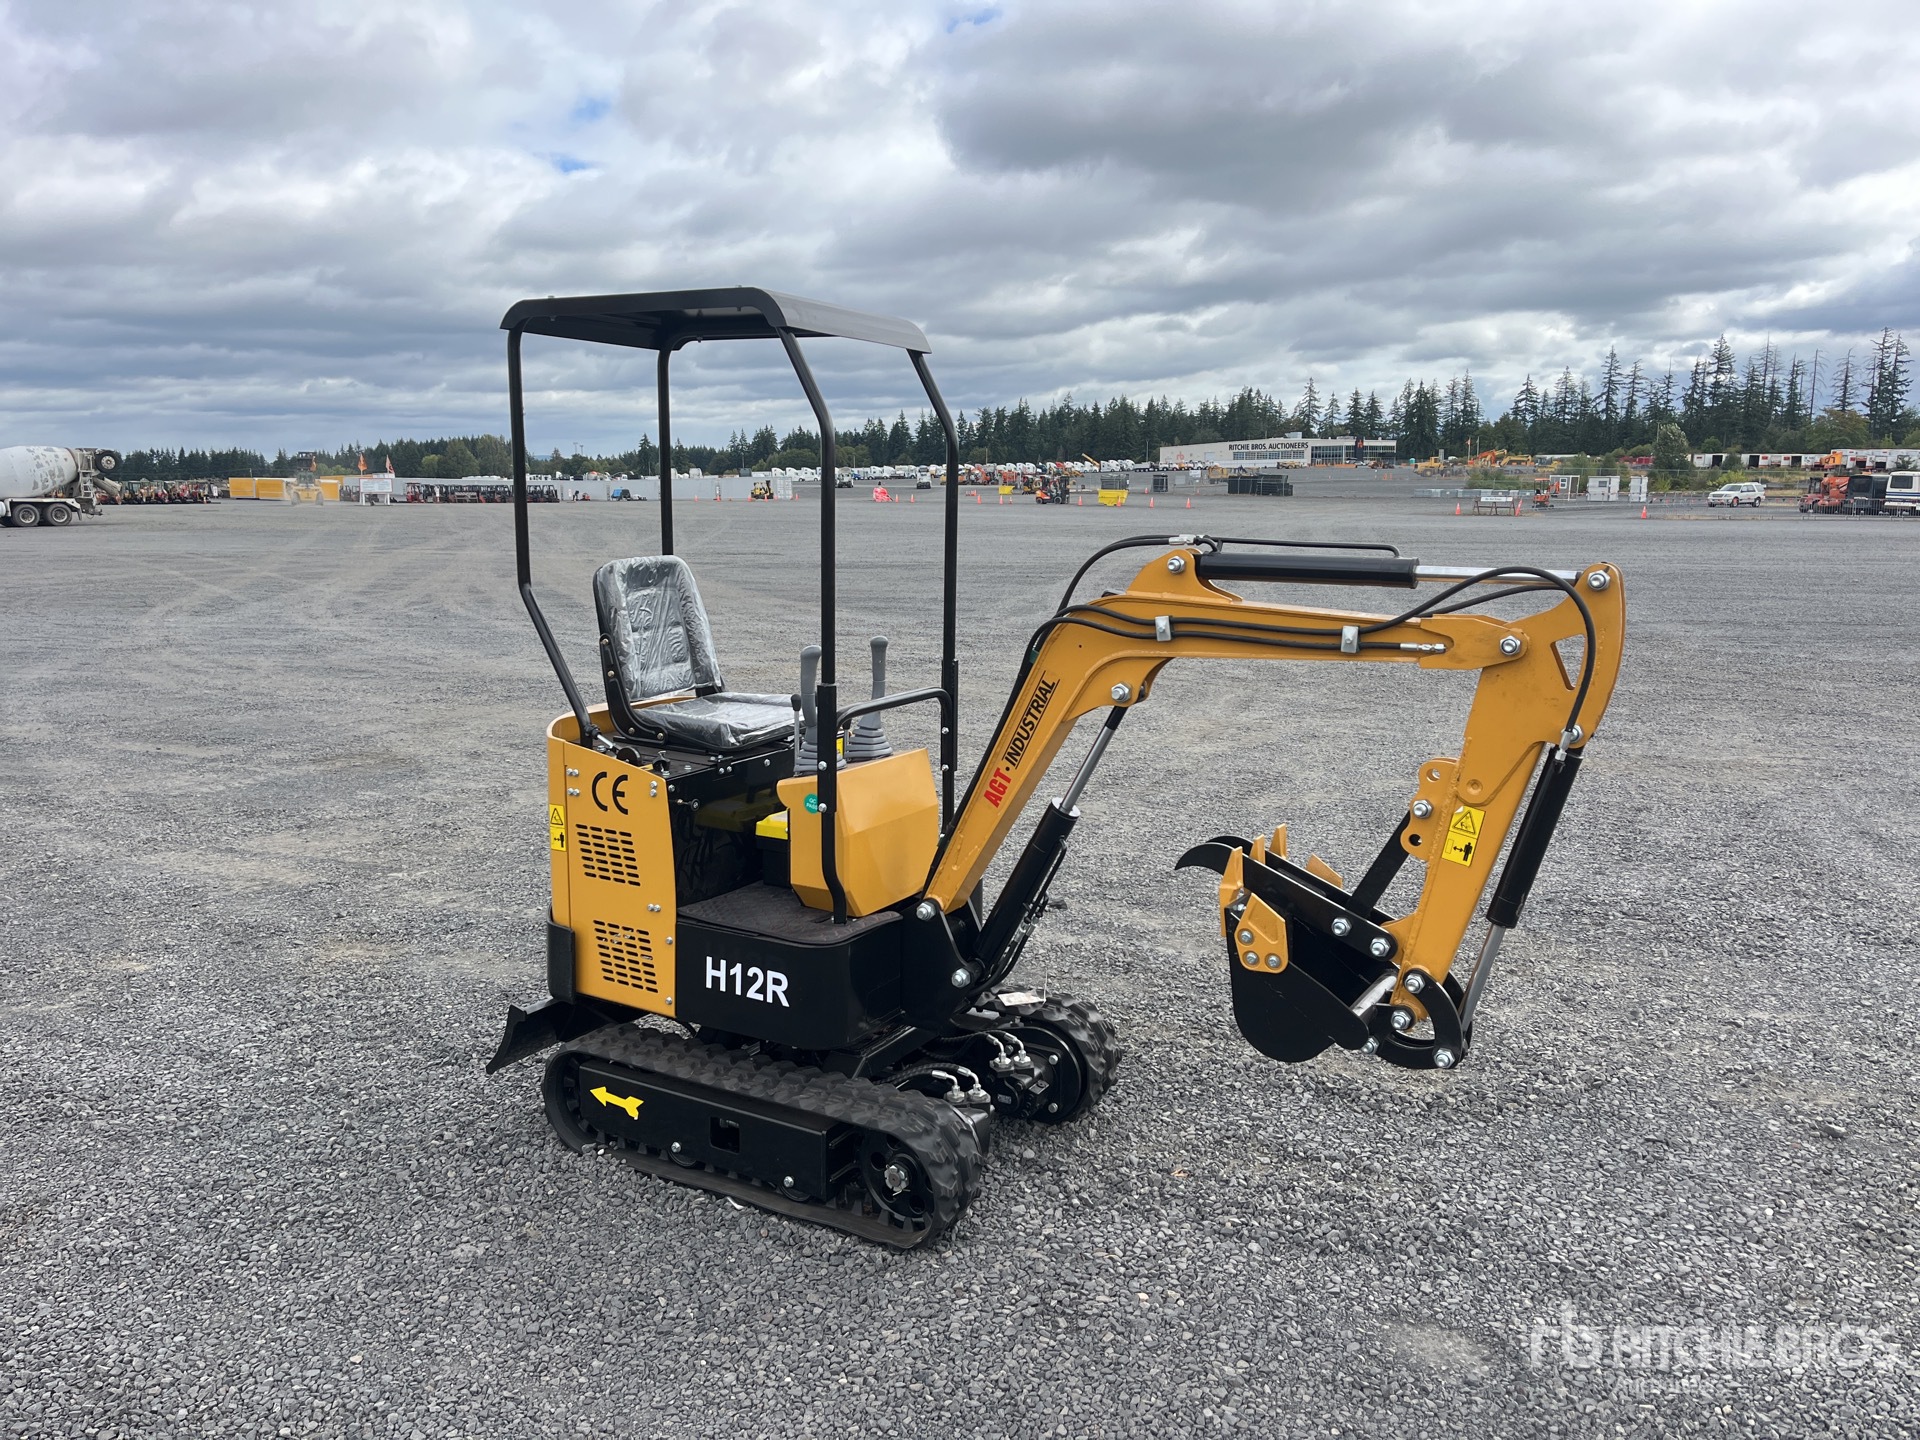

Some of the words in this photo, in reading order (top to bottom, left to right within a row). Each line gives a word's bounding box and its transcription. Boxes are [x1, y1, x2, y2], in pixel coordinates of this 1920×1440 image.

[1228, 443, 1250, 451] RITCHIE
[1268, 441, 1309, 450] AUCTIONEERS
[983, 767, 1012, 808] AGT
[1004, 679, 1056, 768] INDUSTRIAL
[591, 771, 629, 815] CE
[705, 955, 790, 1008] H12R
